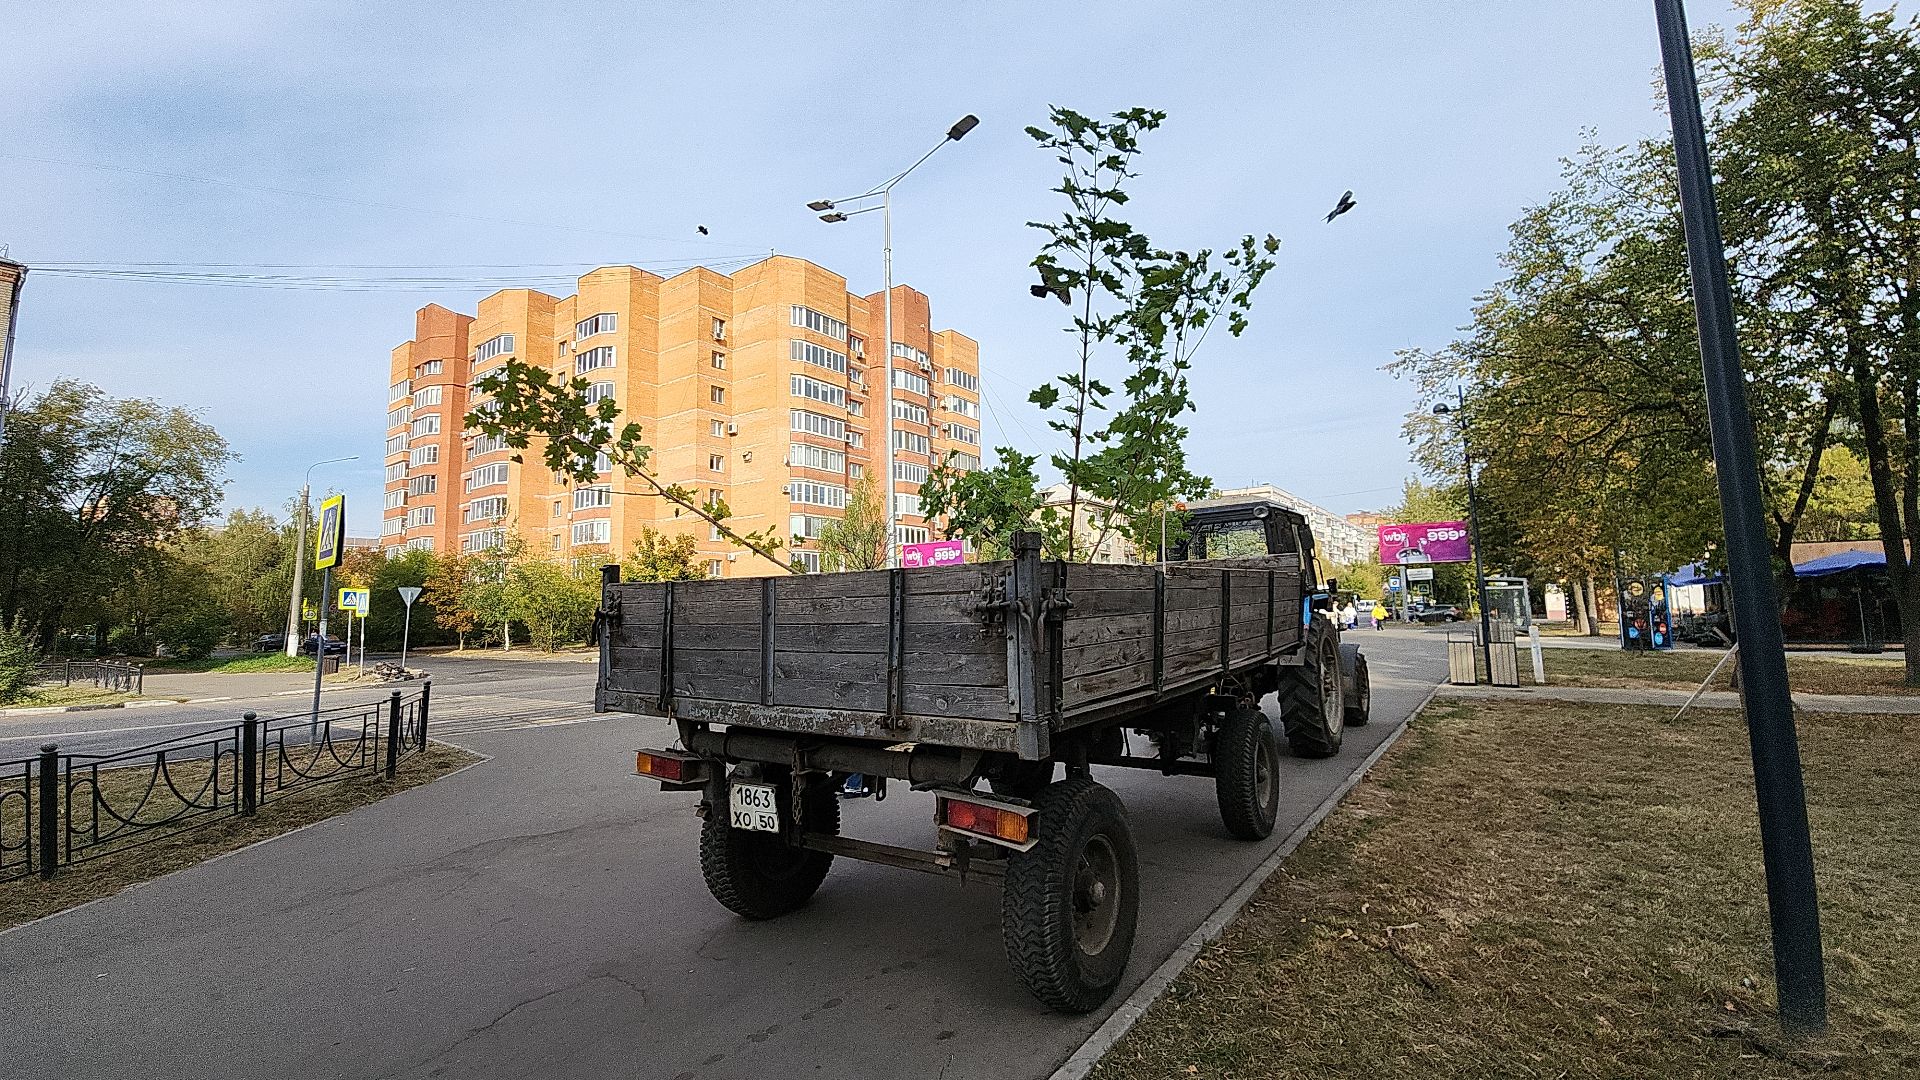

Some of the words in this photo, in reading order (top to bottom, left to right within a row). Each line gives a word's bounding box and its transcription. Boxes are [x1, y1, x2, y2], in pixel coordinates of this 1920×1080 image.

[737, 787, 770, 808] 1863
[734, 811, 751, 826] ХО
[759, 815, 775, 829] 50
